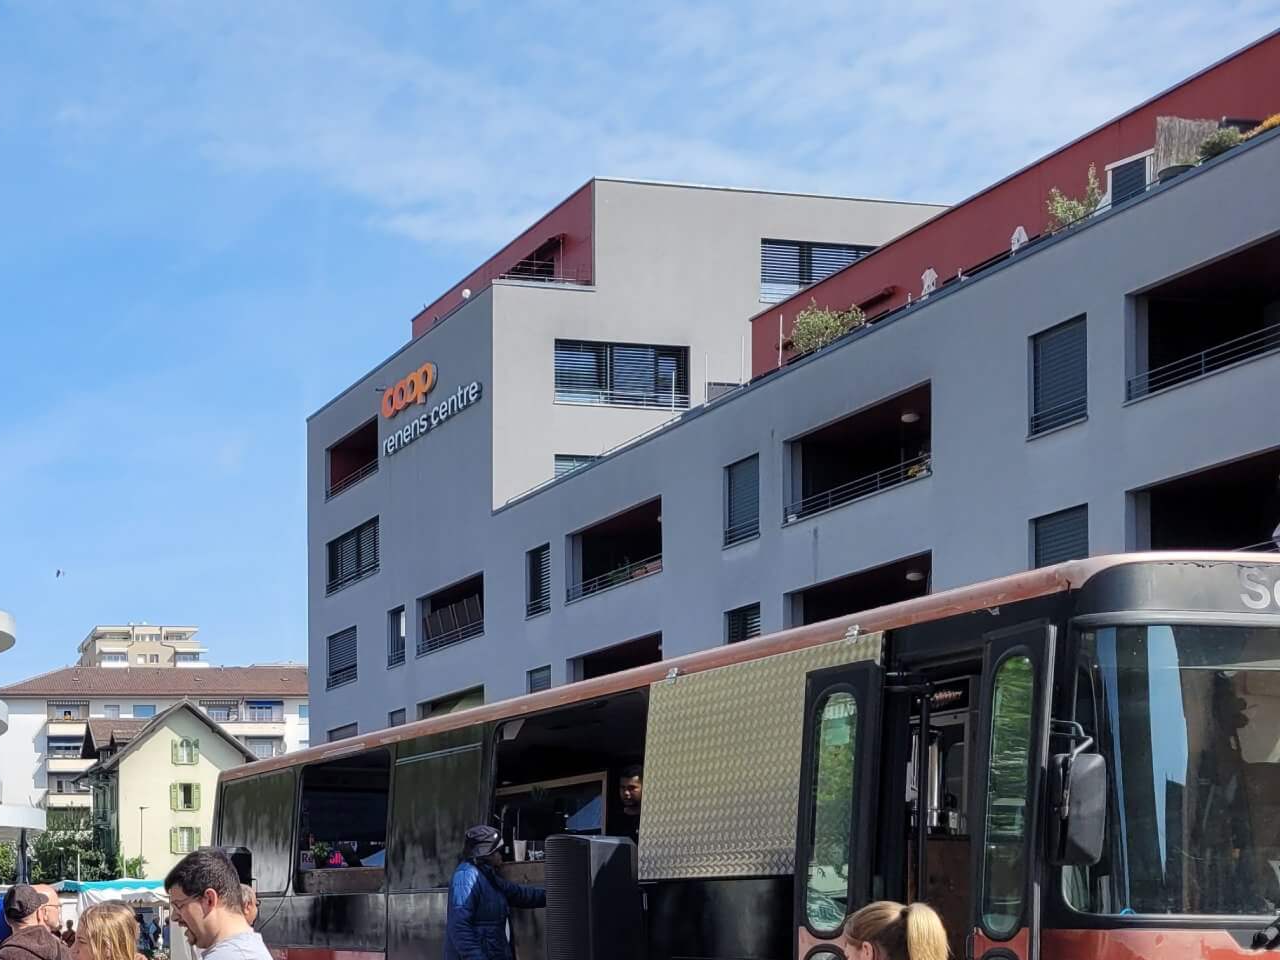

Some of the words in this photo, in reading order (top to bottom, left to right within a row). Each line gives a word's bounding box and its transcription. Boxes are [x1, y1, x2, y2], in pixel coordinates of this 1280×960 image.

[382, 361, 436, 419] coop
[383, 412, 428, 457] renens
[430, 381, 480, 427] centre
[1240, 568, 1280, 610] S
